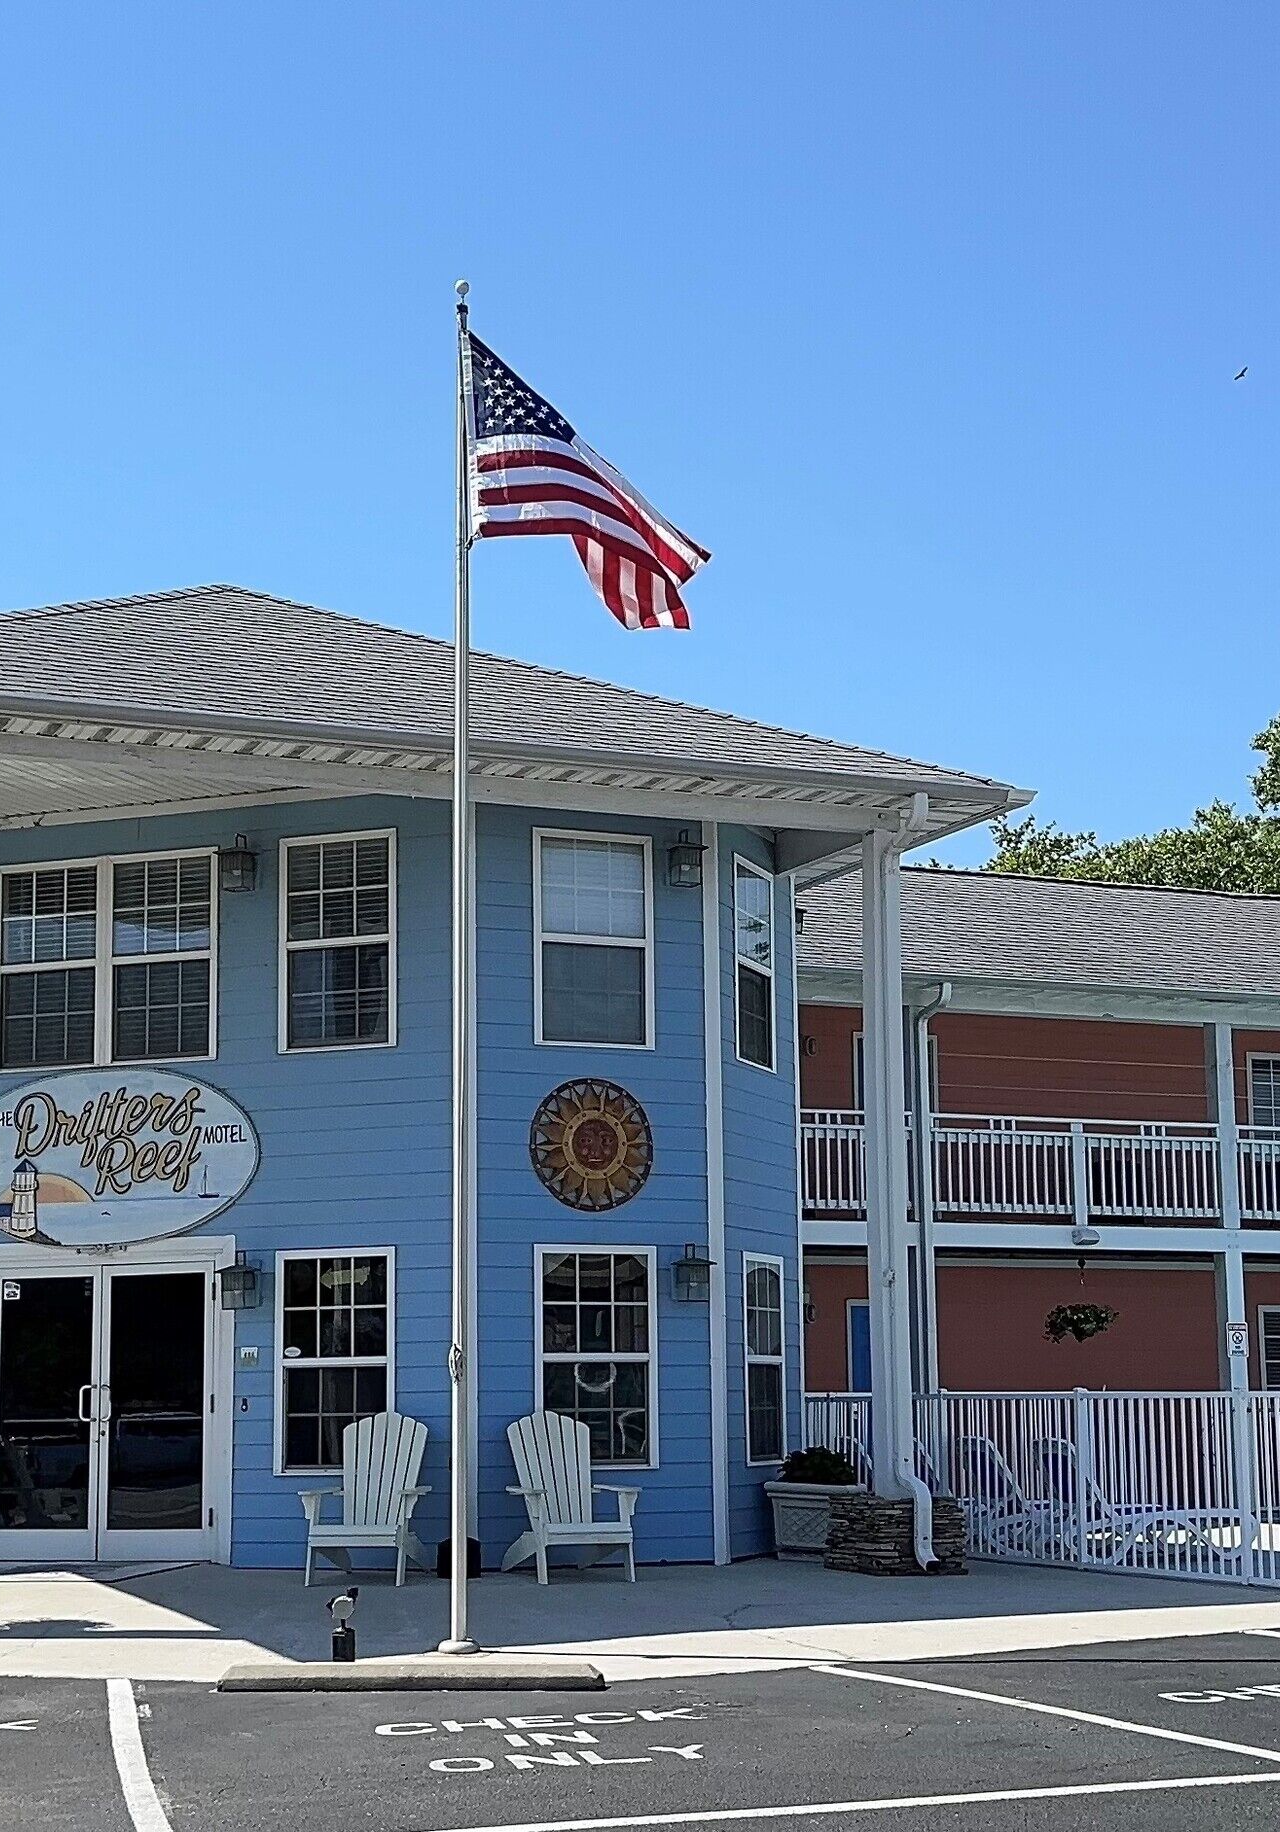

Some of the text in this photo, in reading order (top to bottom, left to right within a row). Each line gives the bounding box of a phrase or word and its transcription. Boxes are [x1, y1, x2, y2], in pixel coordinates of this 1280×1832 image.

[14, 1086, 206, 1168] Drifters
[94, 1124, 248, 1195] Reef MOTEL
[374, 1708, 703, 1736] CHECK
[503, 1730, 600, 1747] IN
[428, 1744, 704, 1773] ONLY
